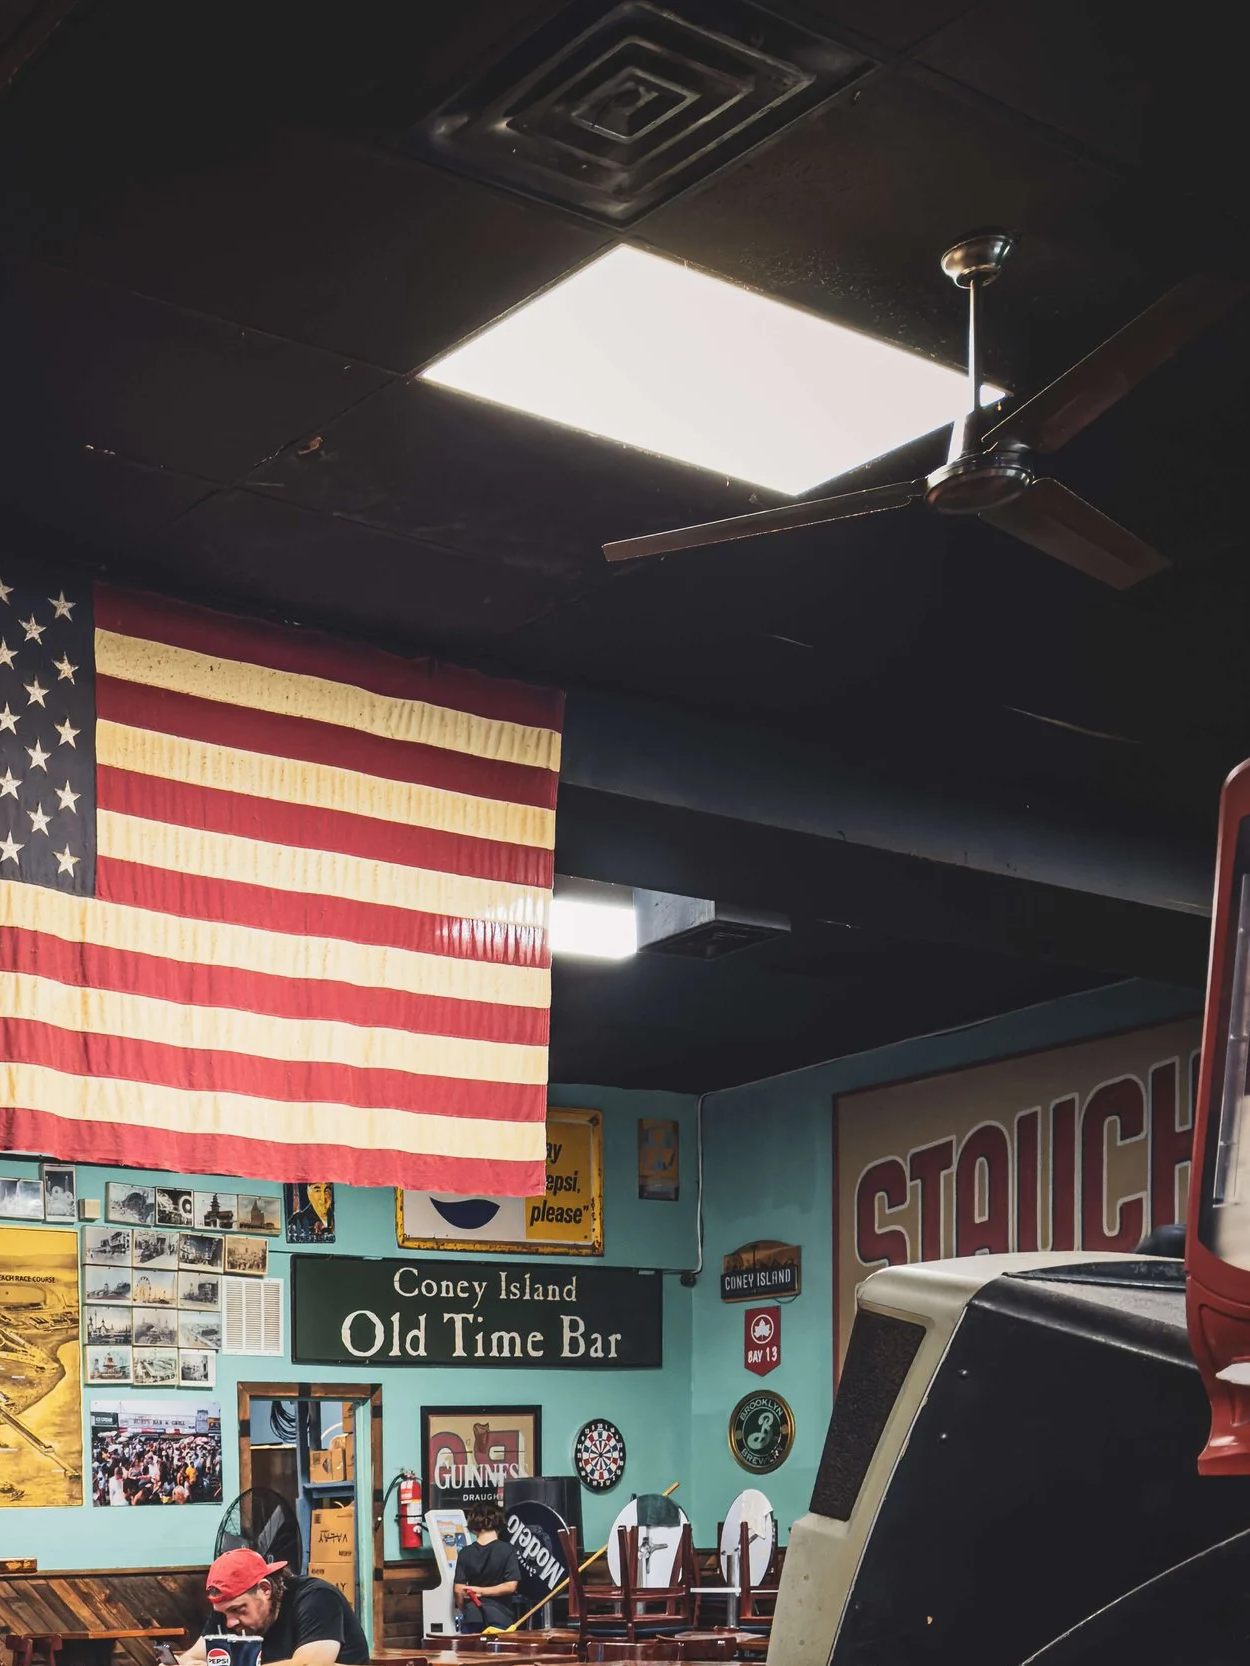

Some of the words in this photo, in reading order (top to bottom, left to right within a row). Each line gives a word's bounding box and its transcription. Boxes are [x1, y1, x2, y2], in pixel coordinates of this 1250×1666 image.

[546, 1141, 562, 1164] ay
[546, 1171, 581, 1196] epsi,
[393, 1267, 488, 1308] Coney
[499, 1271, 578, 1302] Island
[725, 1273, 754, 1290] CONEY
[756, 1268, 791, 1286] ISLAND
[341, 1309, 428, 1357] Old
[443, 1312, 545, 1357] Time
[559, 1314, 622, 1358] Bar
[748, 1350, 763, 1363] BAY
[766, 1346, 778, 1362] 13
[740, 1399, 784, 1422] BROOKLYN
[507, 1514, 566, 1590] Modelo
[209, 1657, 230, 1665] PEPSI
